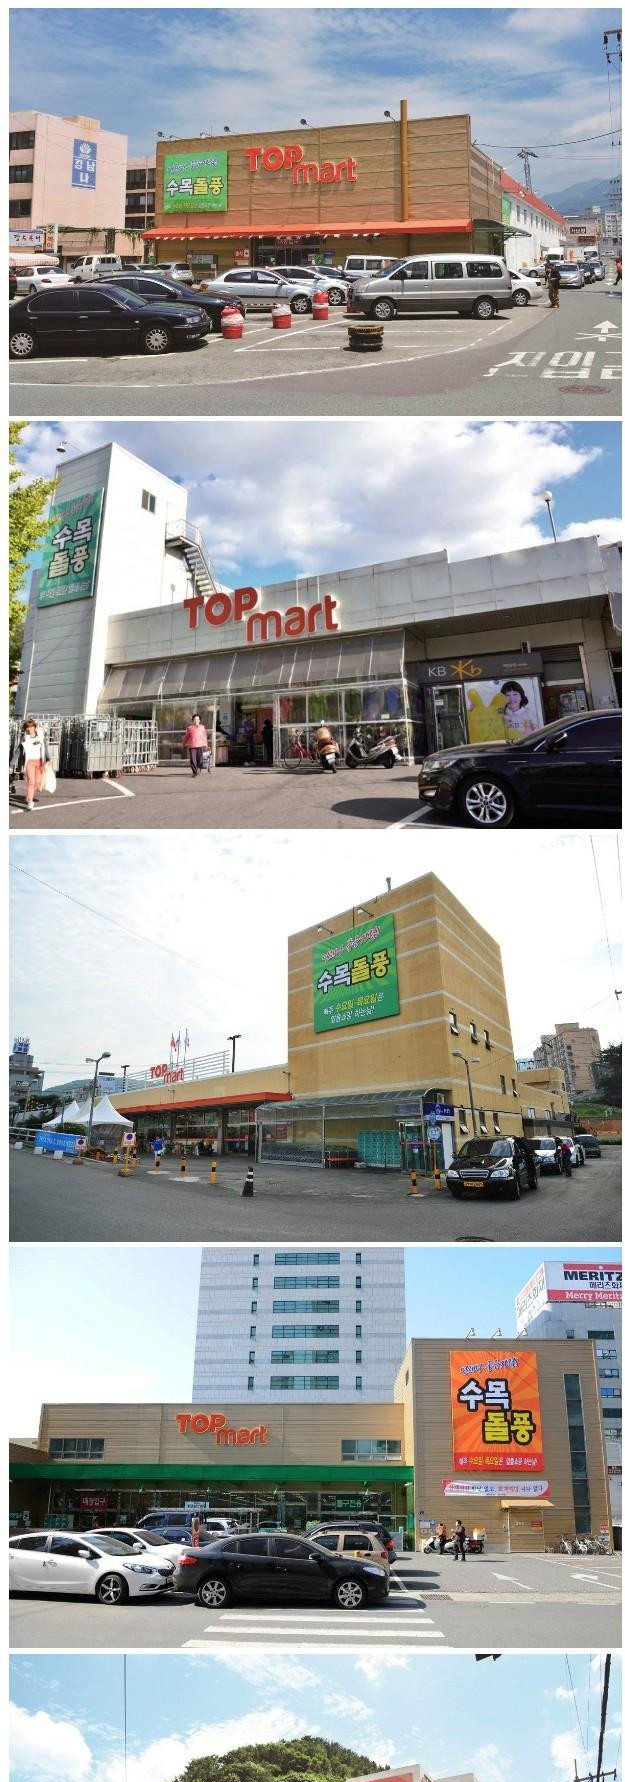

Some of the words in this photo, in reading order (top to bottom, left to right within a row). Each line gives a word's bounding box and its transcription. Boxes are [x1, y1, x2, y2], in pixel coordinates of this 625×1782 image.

[245, 145, 304, 172] TOP
[292, 156, 359, 185] mart
[166, 176, 225, 197] 수목돌풍
[52, 516, 93, 550] 수목
[48, 543, 90, 580] 돌풍
[183, 587, 258, 629] TOP
[246, 595, 338, 641] mart
[428, 666, 447, 677] KB
[317, 948, 391, 994] 수목돌풍
[150, 1063, 168, 1080] TOP
[163, 1067, 184, 1084] mart
[564, 1291, 593, 1301] Merry
[458, 1378, 512, 1412] 수목
[176, 1413, 226, 1434] TOP
[216, 1424, 269, 1445] mart
[482, 1410, 536, 1445] 돌풍
